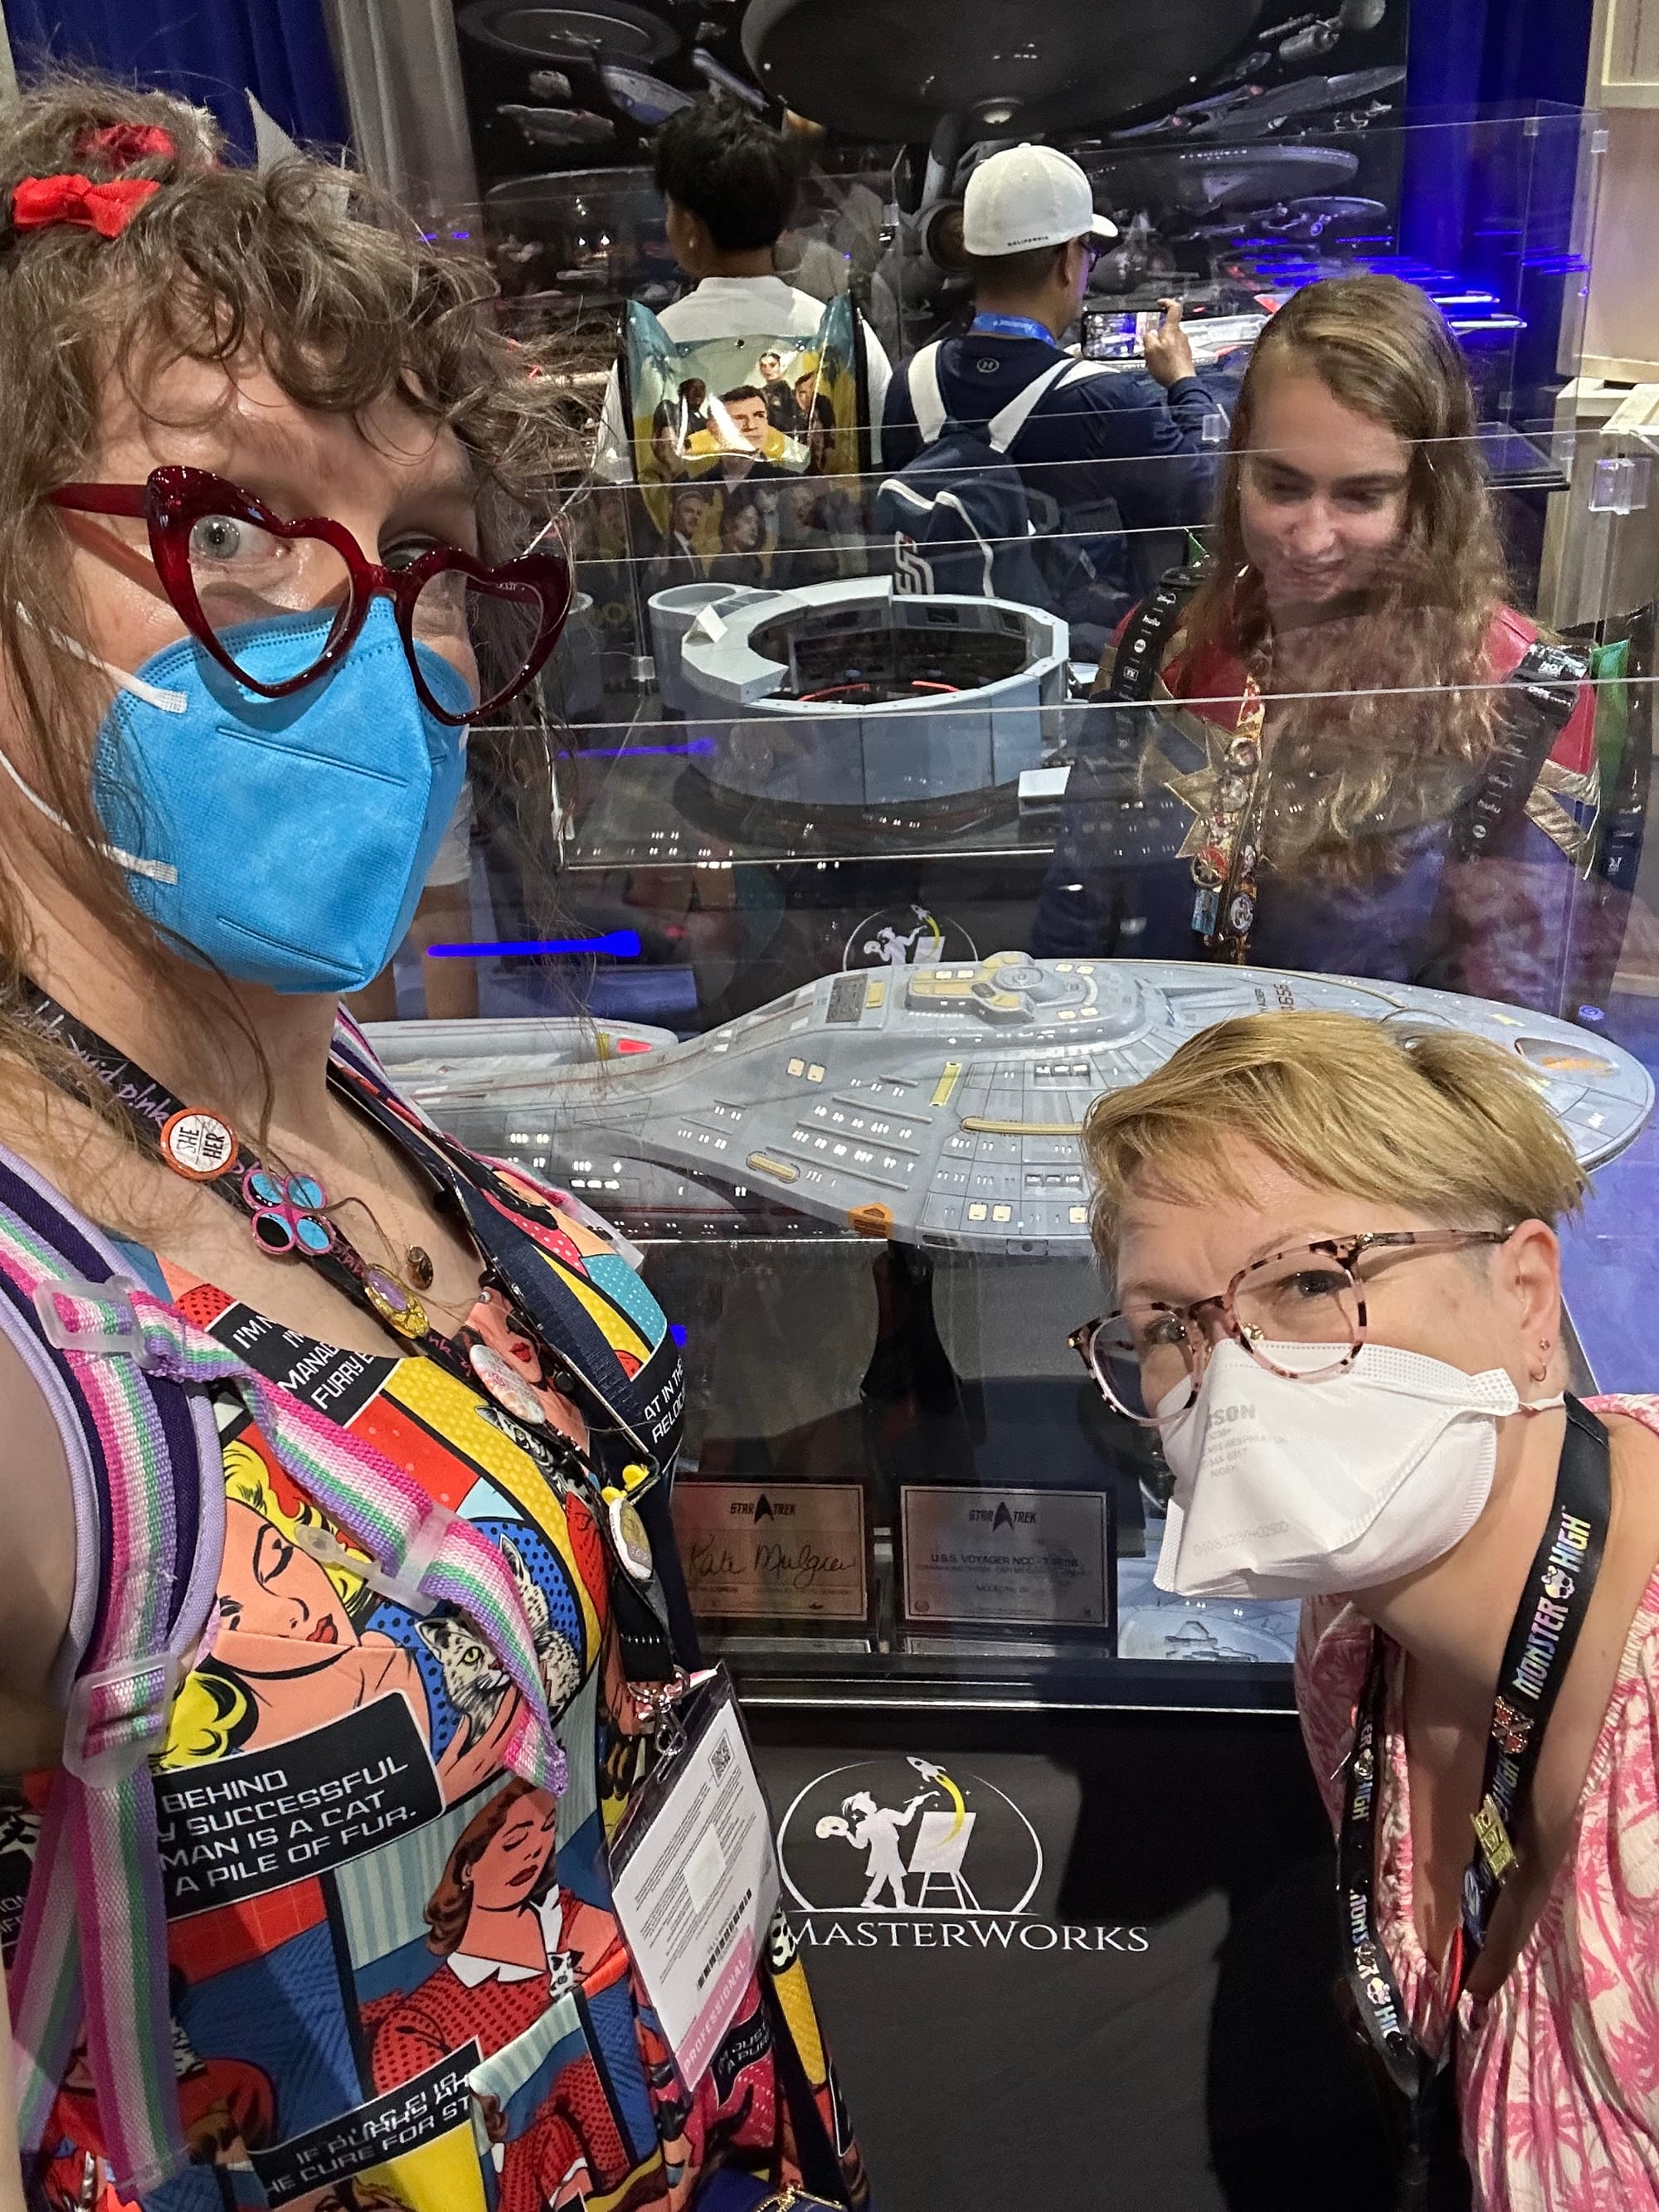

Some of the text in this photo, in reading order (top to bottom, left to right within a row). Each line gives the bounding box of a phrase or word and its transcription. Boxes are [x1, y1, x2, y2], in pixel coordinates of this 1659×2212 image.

[176, 1126, 200, 1155] SHE
[202, 1132, 226, 1160] HER
[310, 1355, 365, 1410] FURRY
[663, 1383, 679, 1405] IN
[1209, 1404, 1256, 1426] SON
[730, 1503, 796, 1516] STAR TREK
[968, 1510, 1037, 1524] STAR TREK
[961, 1554, 1010, 1566] VOYAGER
[1511, 1512, 1591, 1700] MONSTER HIGH
[161, 1769, 289, 1814] BEHIND
[186, 1756, 410, 1836] SUCCESSFUL
[158, 1790, 386, 1872] MAN IS A CAT
[175, 1806, 418, 1898] A PILE OF FUR.
[683, 1958, 747, 2073] PROFESSIONAL
[299, 2145, 376, 2182] CURE
[382, 2114, 436, 2151] FOR
